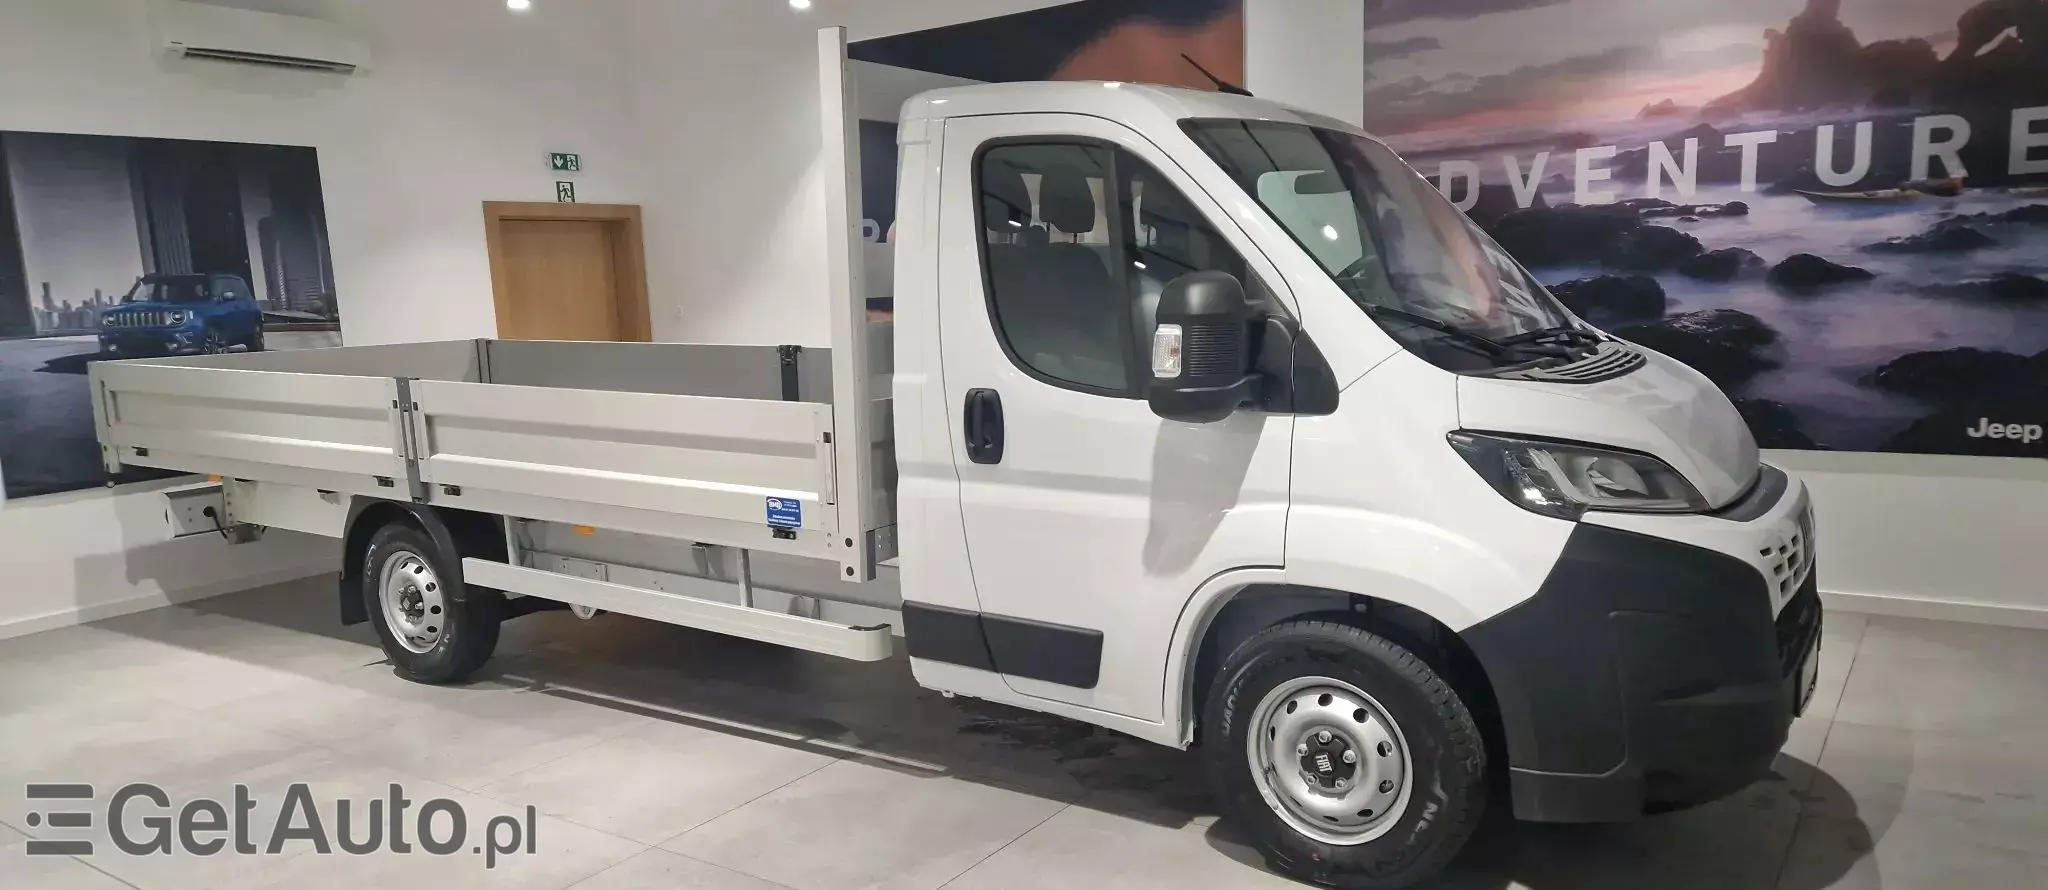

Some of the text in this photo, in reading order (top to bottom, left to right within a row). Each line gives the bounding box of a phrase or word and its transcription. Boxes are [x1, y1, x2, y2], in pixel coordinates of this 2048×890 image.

[1438, 105, 2048, 213] DVENTURE
[1966, 416, 2043, 444] Jeep
[1315, 753, 1333, 772] FIAT
